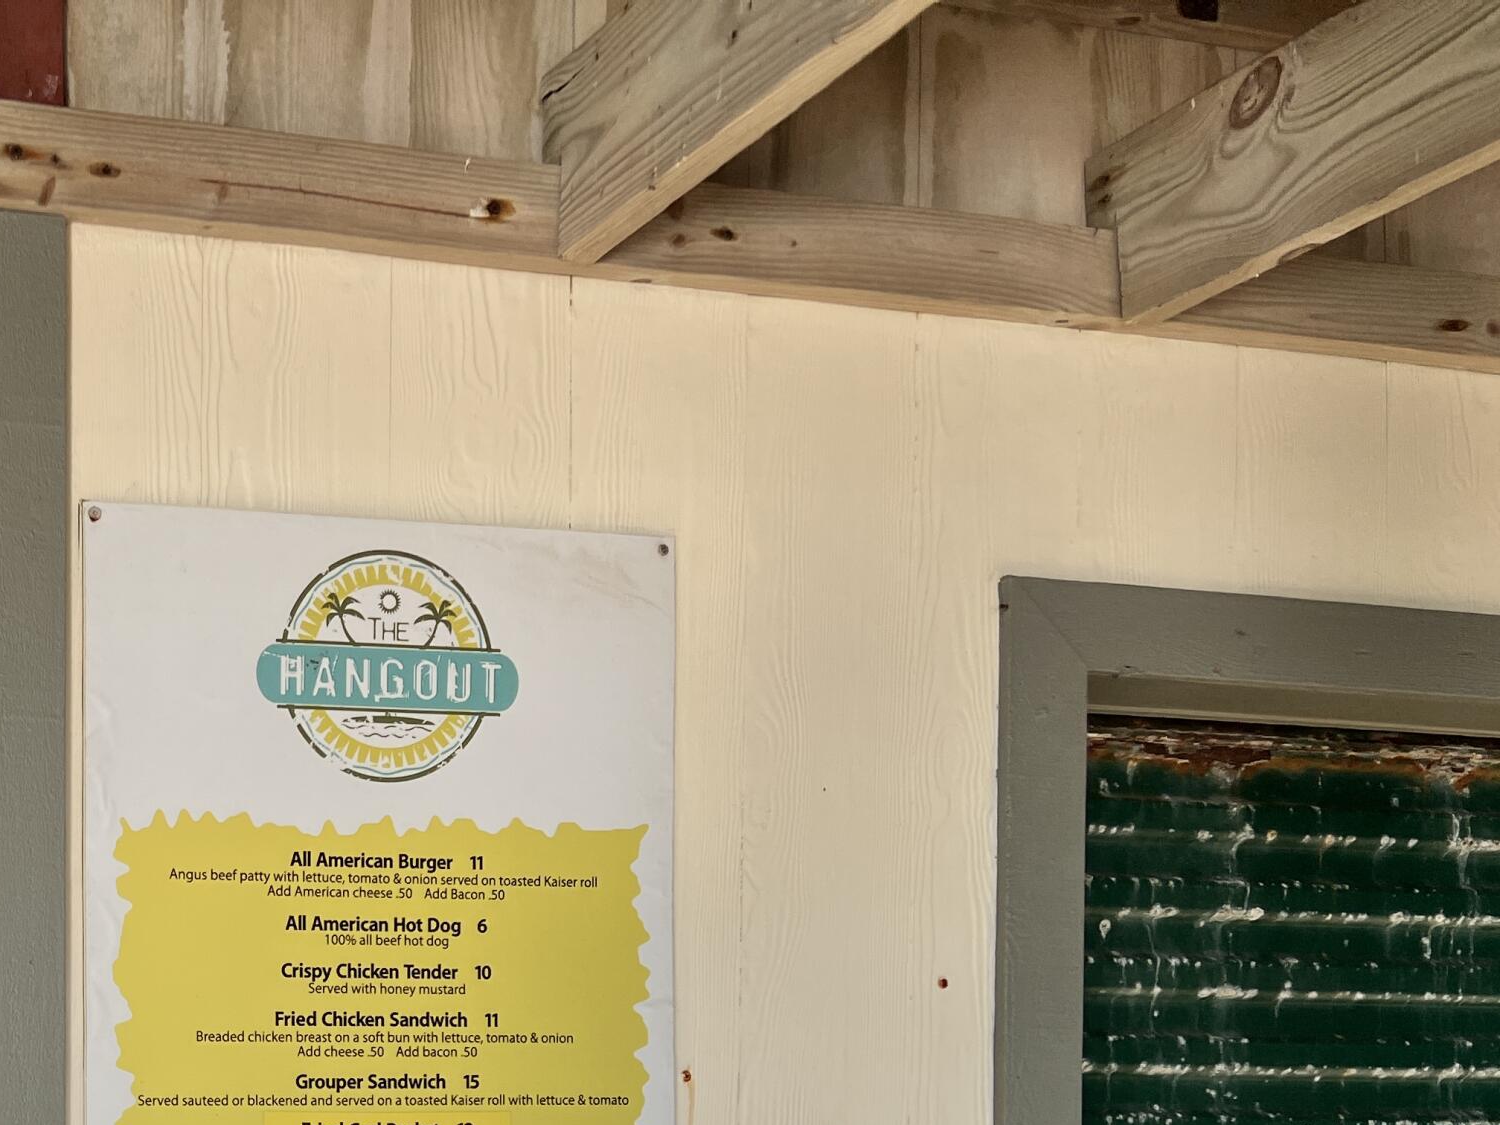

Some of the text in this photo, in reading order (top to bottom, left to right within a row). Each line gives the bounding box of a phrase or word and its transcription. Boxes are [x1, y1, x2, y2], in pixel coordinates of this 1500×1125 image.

[368, 617, 410, 642] THE
[279, 655, 502, 704] HANGOUT
[290, 850, 483, 874] All American Burger 11
[169, 867, 598, 888] Angus beef patty with lettuce, tomato & onion served on toasted Kaiser roll
[285, 914, 488, 938] All American Hot Dog 6
[325, 933, 449, 950] 100% all beef hot dog
[281, 962, 492, 982] Crispy Chicken Tender 10
[308, 982, 466, 998] Served with honey mustard
[275, 1010, 499, 1028] Fried Chicken Sandwich 11
[196, 1030, 574, 1045] Breaded chicken breast on a soft bun with lettuce, tomato & onion
[295, 1073, 480, 1094] Grouper Sandwich 15
[138, 1093, 629, 1107] Served sauteed or blackened and served on a toasted Kaiser roll with lettuce & tomato
